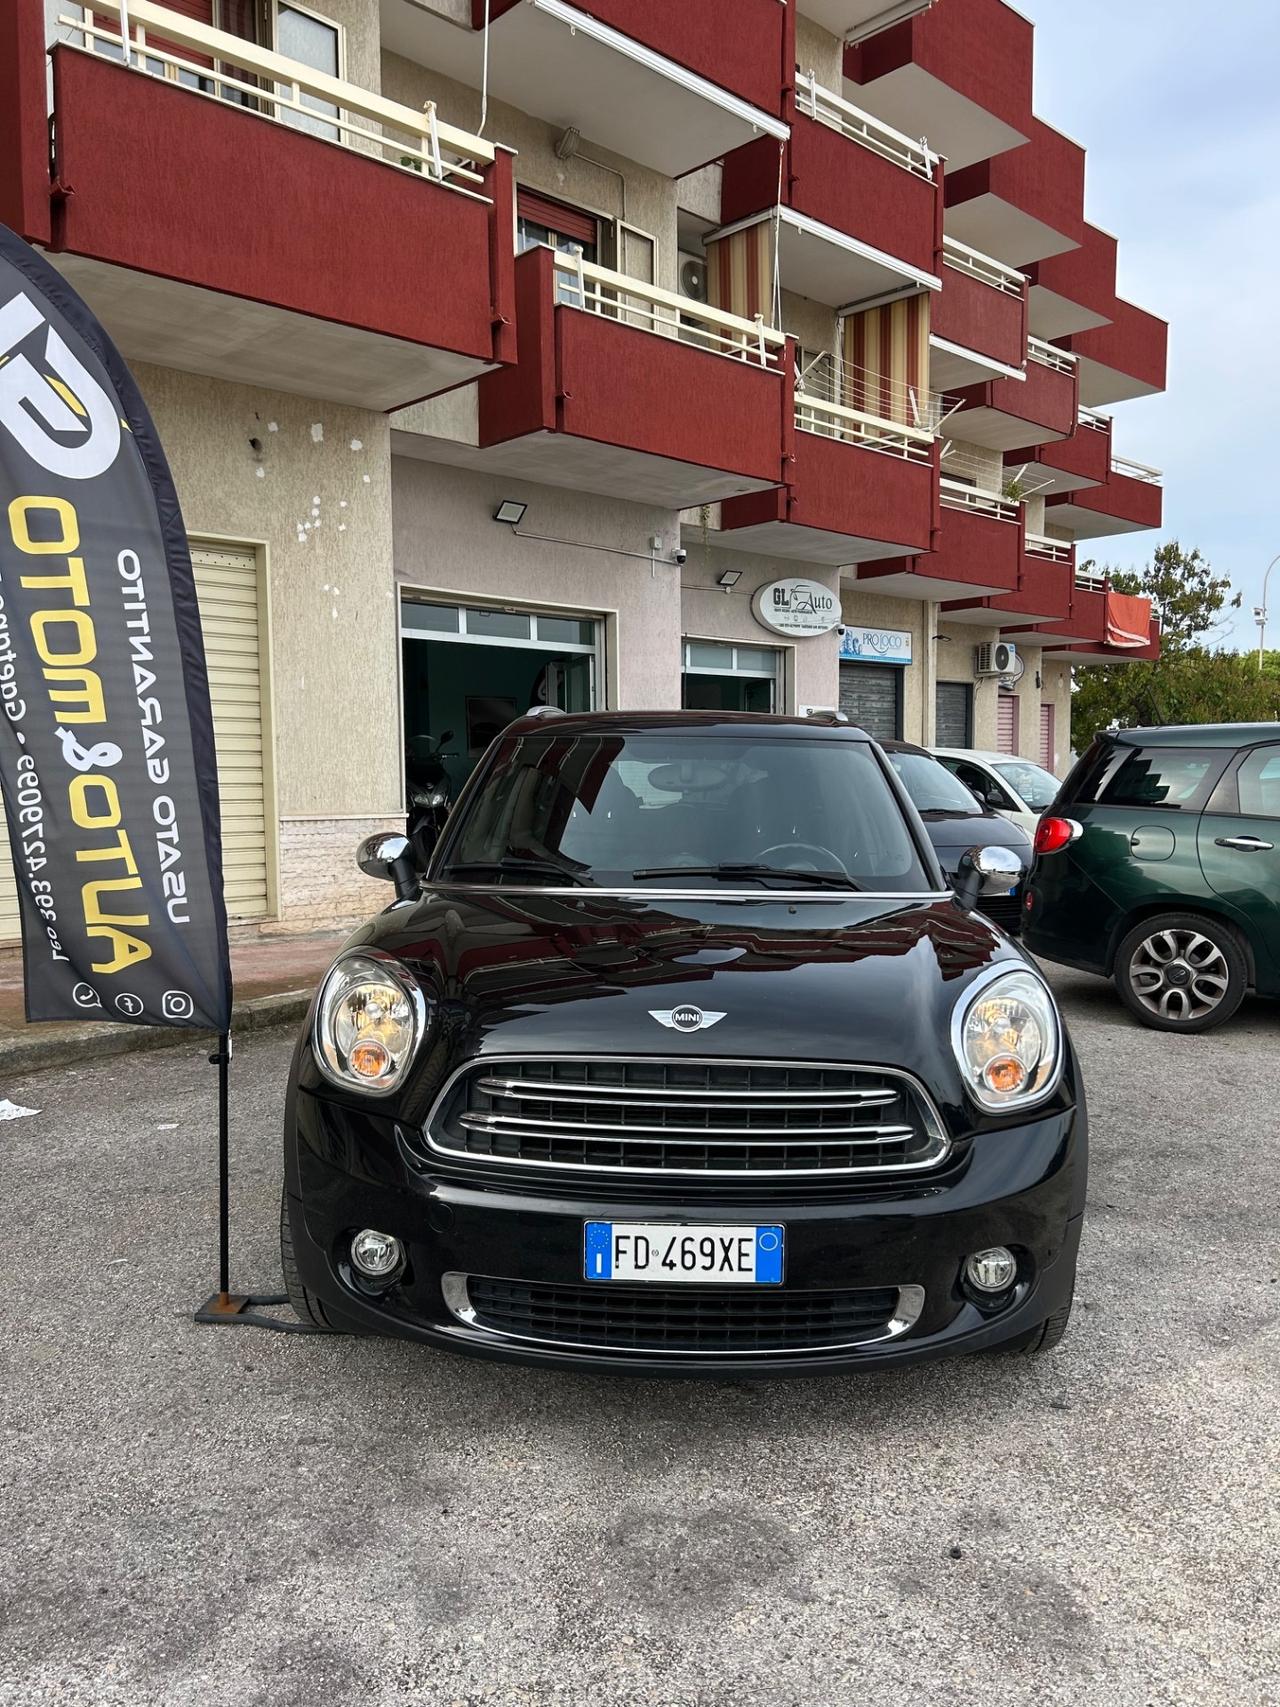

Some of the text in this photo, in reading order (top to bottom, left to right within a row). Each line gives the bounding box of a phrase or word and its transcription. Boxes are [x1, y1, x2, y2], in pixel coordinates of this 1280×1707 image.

[773, 588, 833, 614] GL Auto
[675, 1013, 700, 1022] MINI
